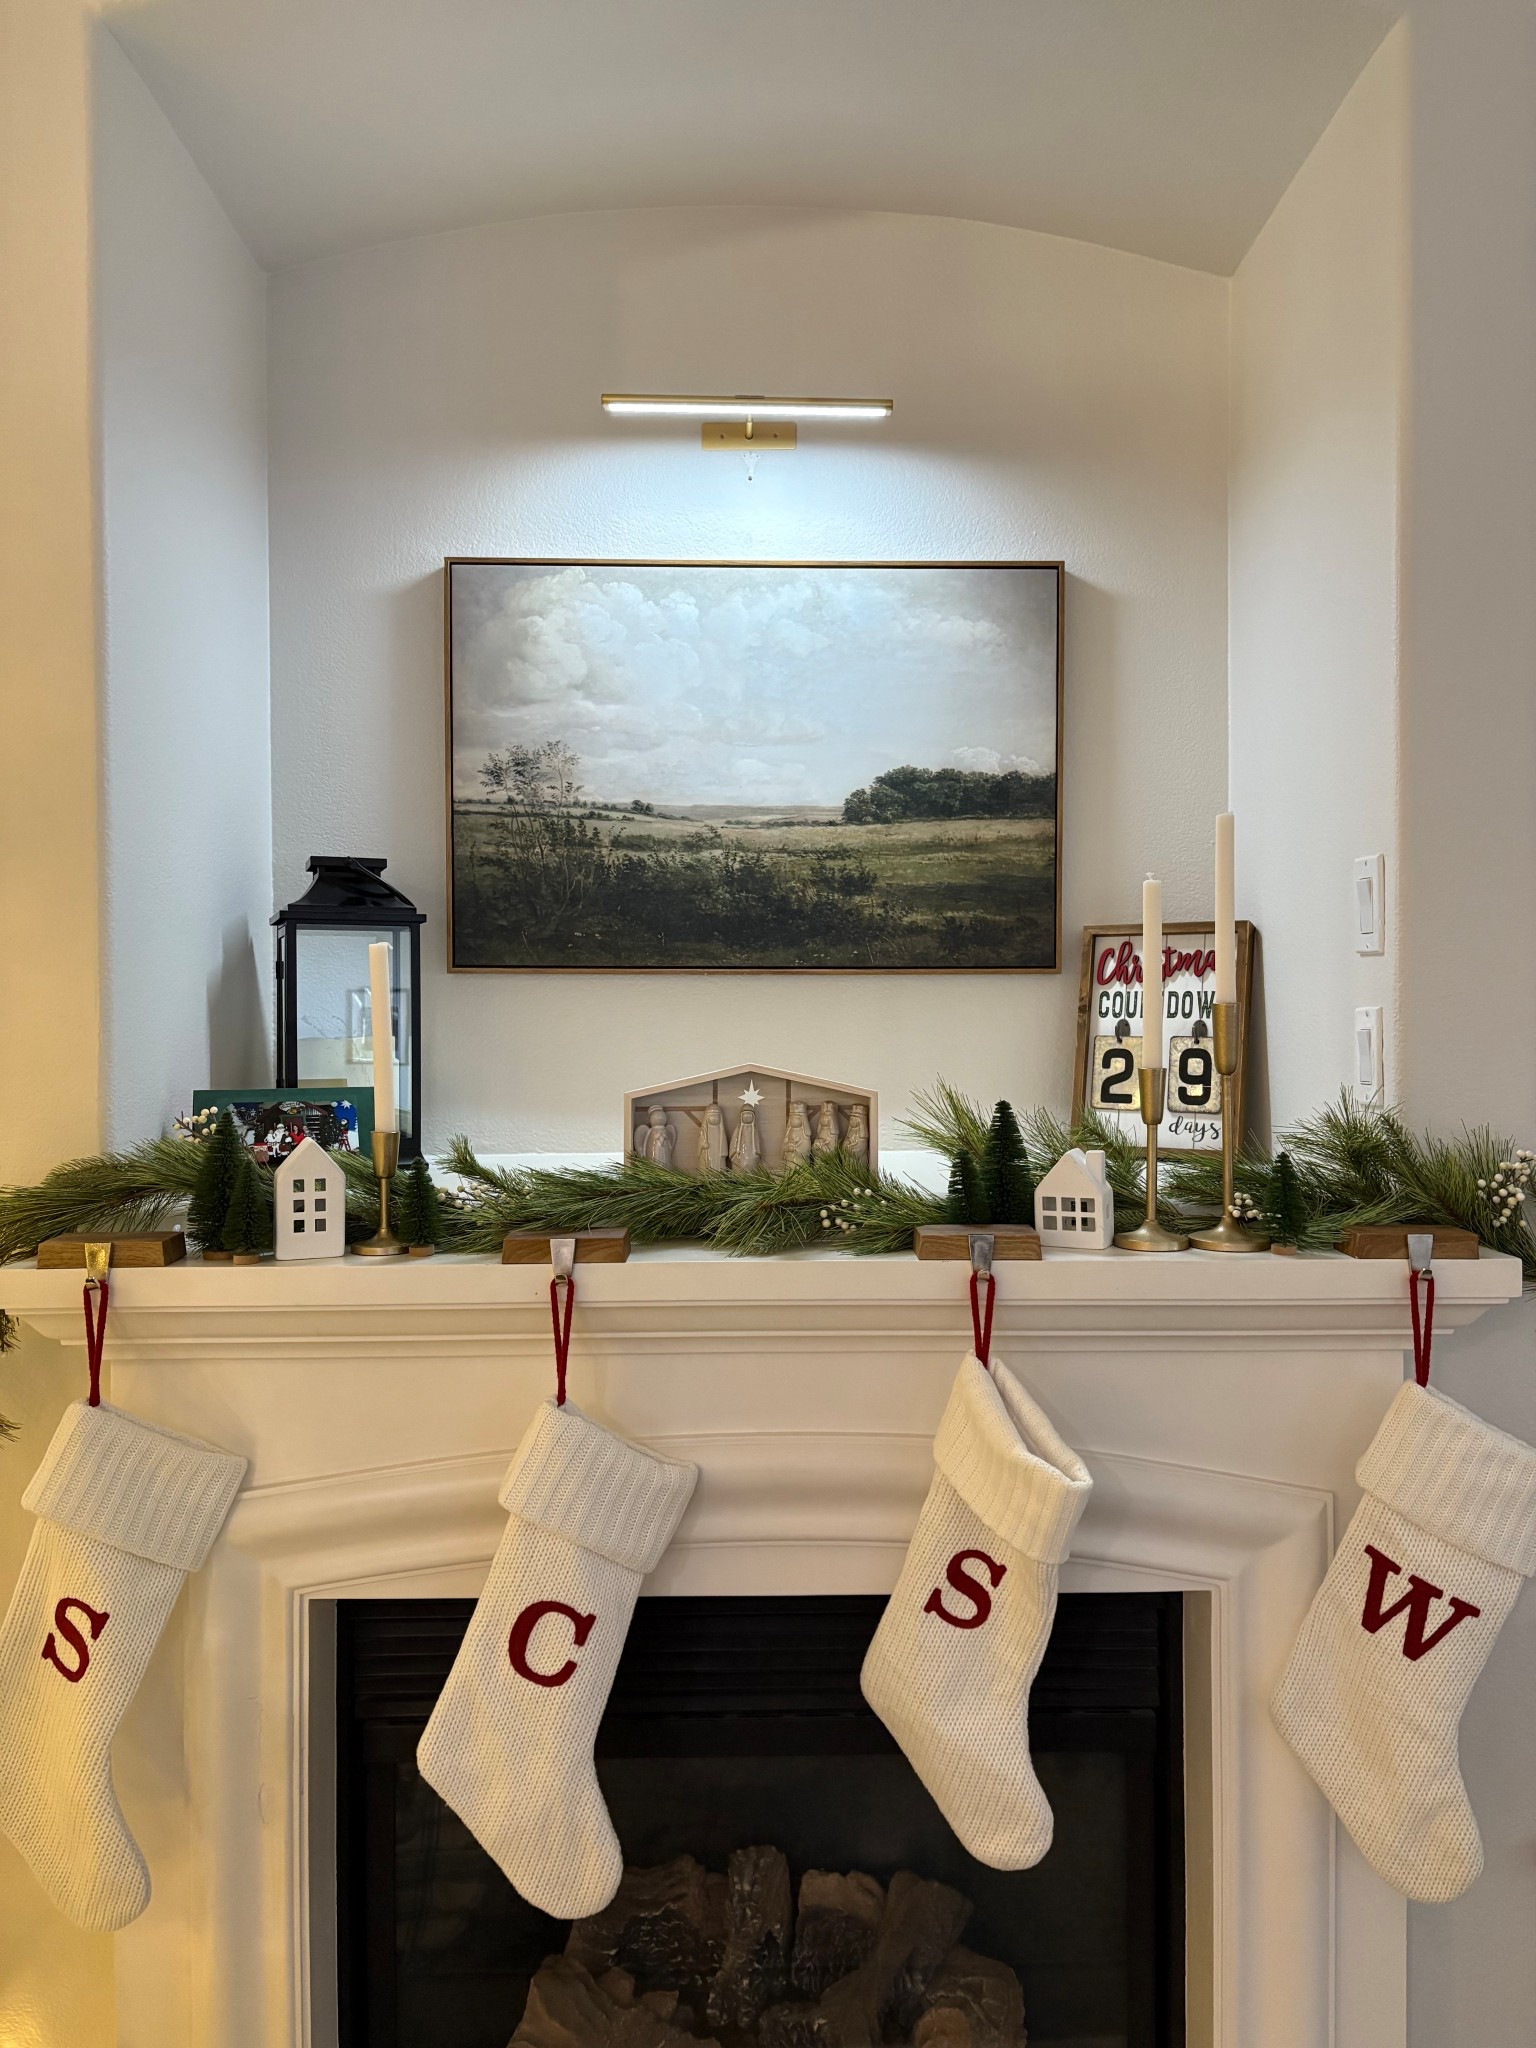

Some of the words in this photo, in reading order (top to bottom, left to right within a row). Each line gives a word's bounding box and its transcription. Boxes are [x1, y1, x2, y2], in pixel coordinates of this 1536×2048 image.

[1097, 941, 1215, 985] Chrtma
[1099, 990, 1215, 1019] COUDOW
[1168, 1115, 1221, 1142] days
[924, 1549, 1007, 1630] S
[1364, 1544, 1480, 1662] W
[42, 1597, 109, 1683] S
[508, 1600, 597, 1687] C
